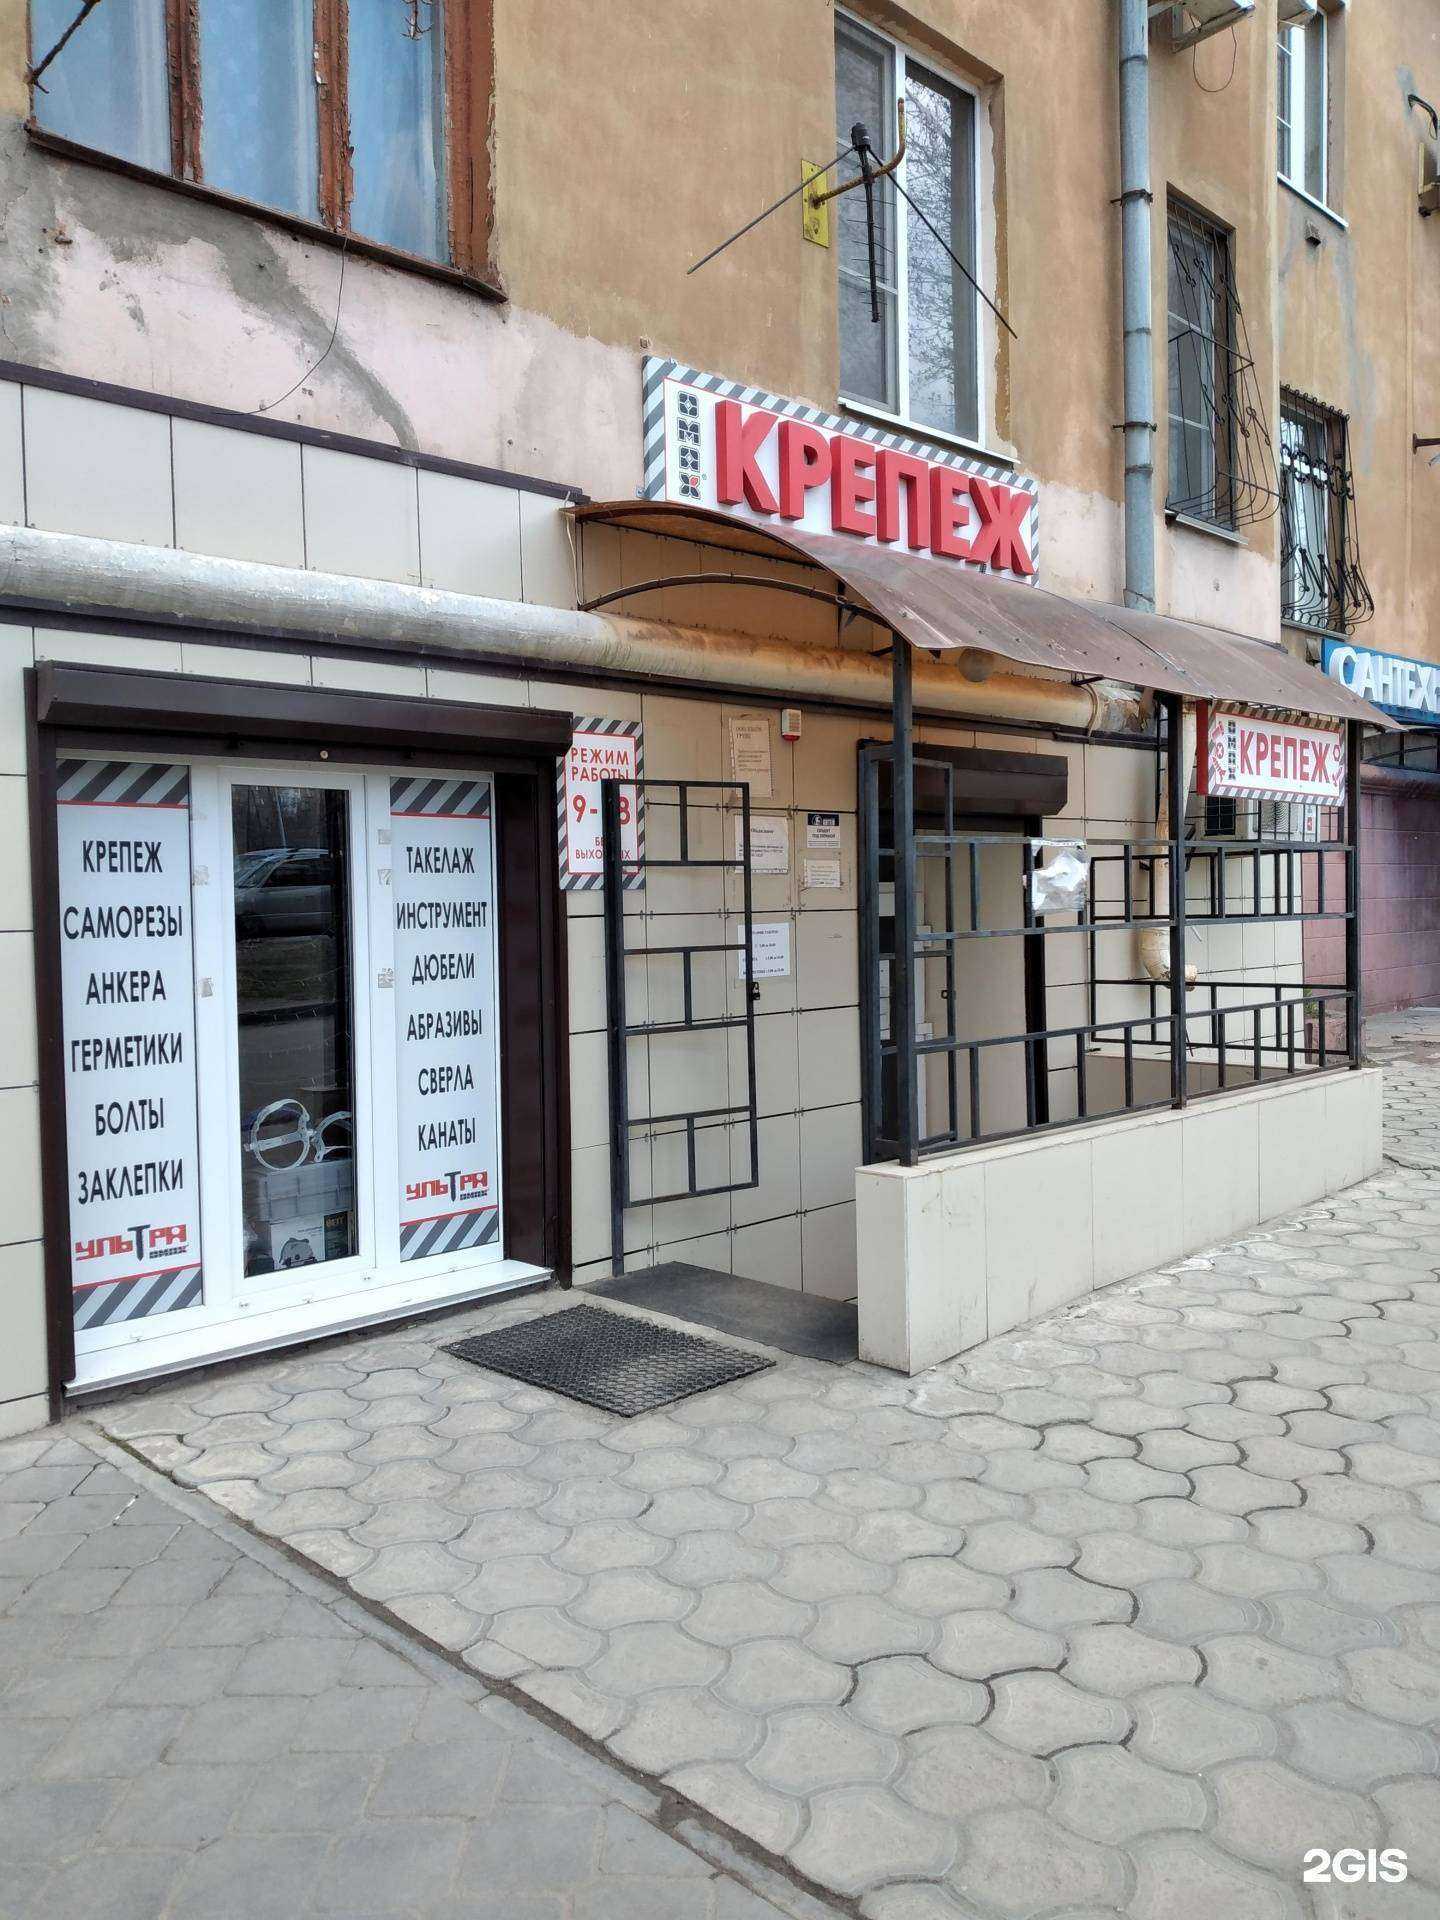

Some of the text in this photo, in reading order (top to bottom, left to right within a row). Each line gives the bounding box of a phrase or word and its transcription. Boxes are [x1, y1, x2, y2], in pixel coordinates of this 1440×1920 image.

[715, 400, 1034, 575] КРЕПЕЖ
[570, 747, 630, 766] РЕЖИМ
[1239, 729, 1331, 784] КРЕПЕЖ
[571, 765, 630, 782] РАБОТЫ
[572, 794, 631, 825] 9-8
[82, 840, 163, 873] КРЕПЕЖ
[406, 846, 475, 874] ТАКЕЛАЖ
[63, 904, 184, 940] САМОРЕЗЫ
[396, 901, 488, 930] ИНСТРУМЕНТ
[412, 953, 475, 986] ДЮБЕЛИ
[86, 969, 167, 1005] АНКЕРА
[406, 1009, 482, 1042] АБРАЗИВЫ
[71, 1032, 184, 1073] ГЕРМЕТИКИ
[418, 1064, 474, 1096] СВЕРЛА
[95, 1097, 165, 1137] БОЛТЫ
[418, 1117, 476, 1151] КАНАТЫ
[77, 1158, 184, 1205] ЗАКЛЕПКИ
